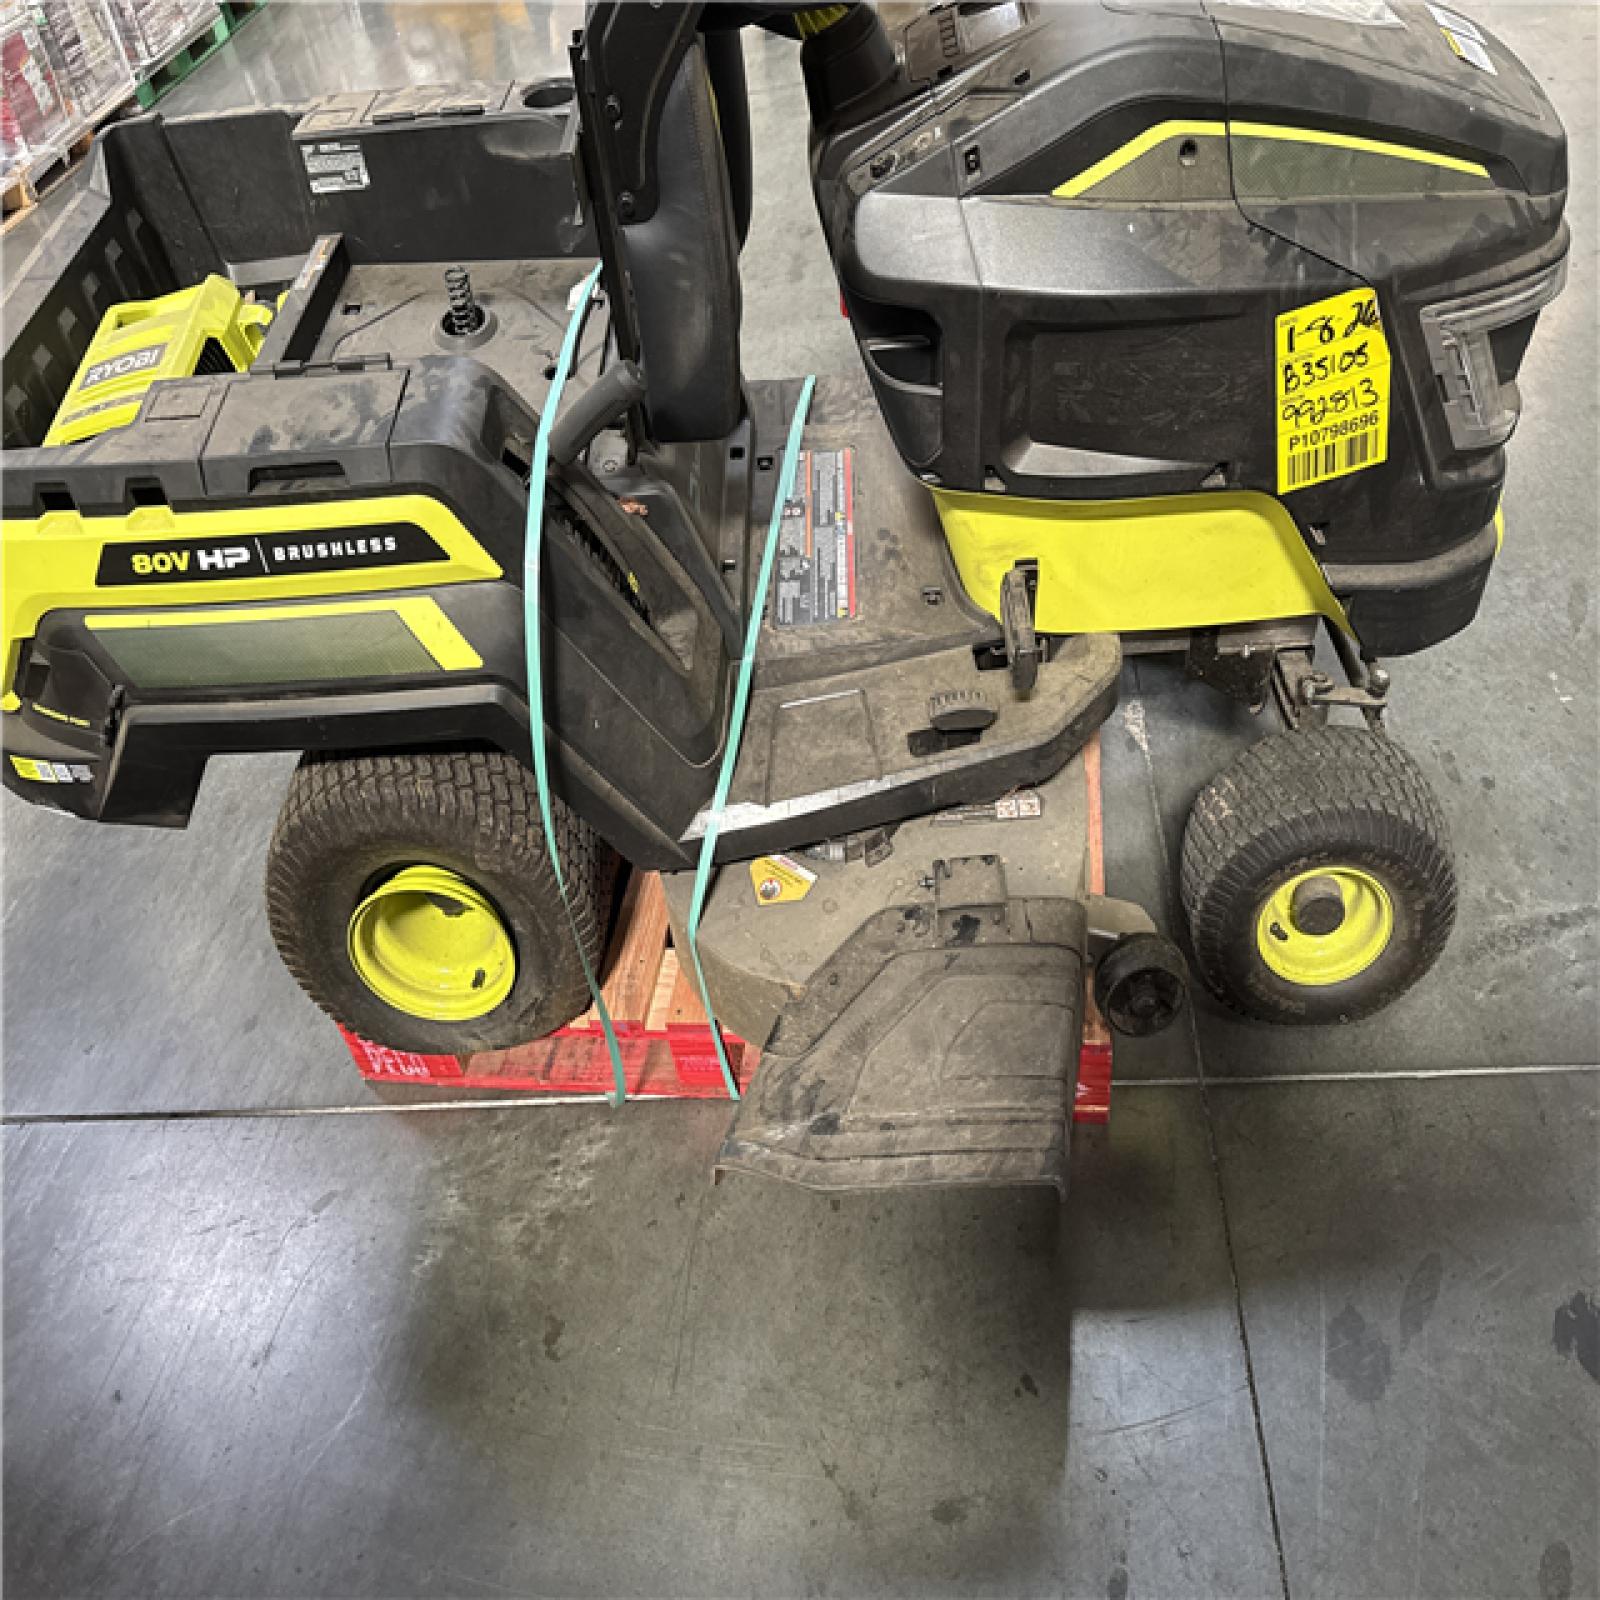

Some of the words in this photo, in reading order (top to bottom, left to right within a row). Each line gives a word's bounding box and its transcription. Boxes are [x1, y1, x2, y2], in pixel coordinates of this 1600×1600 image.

[83, 348, 161, 387] RYOBI
[131, 550, 190, 575] 80V
[197, 546, 251, 571] HP
[273, 536, 397, 561] BRUSHLESS
